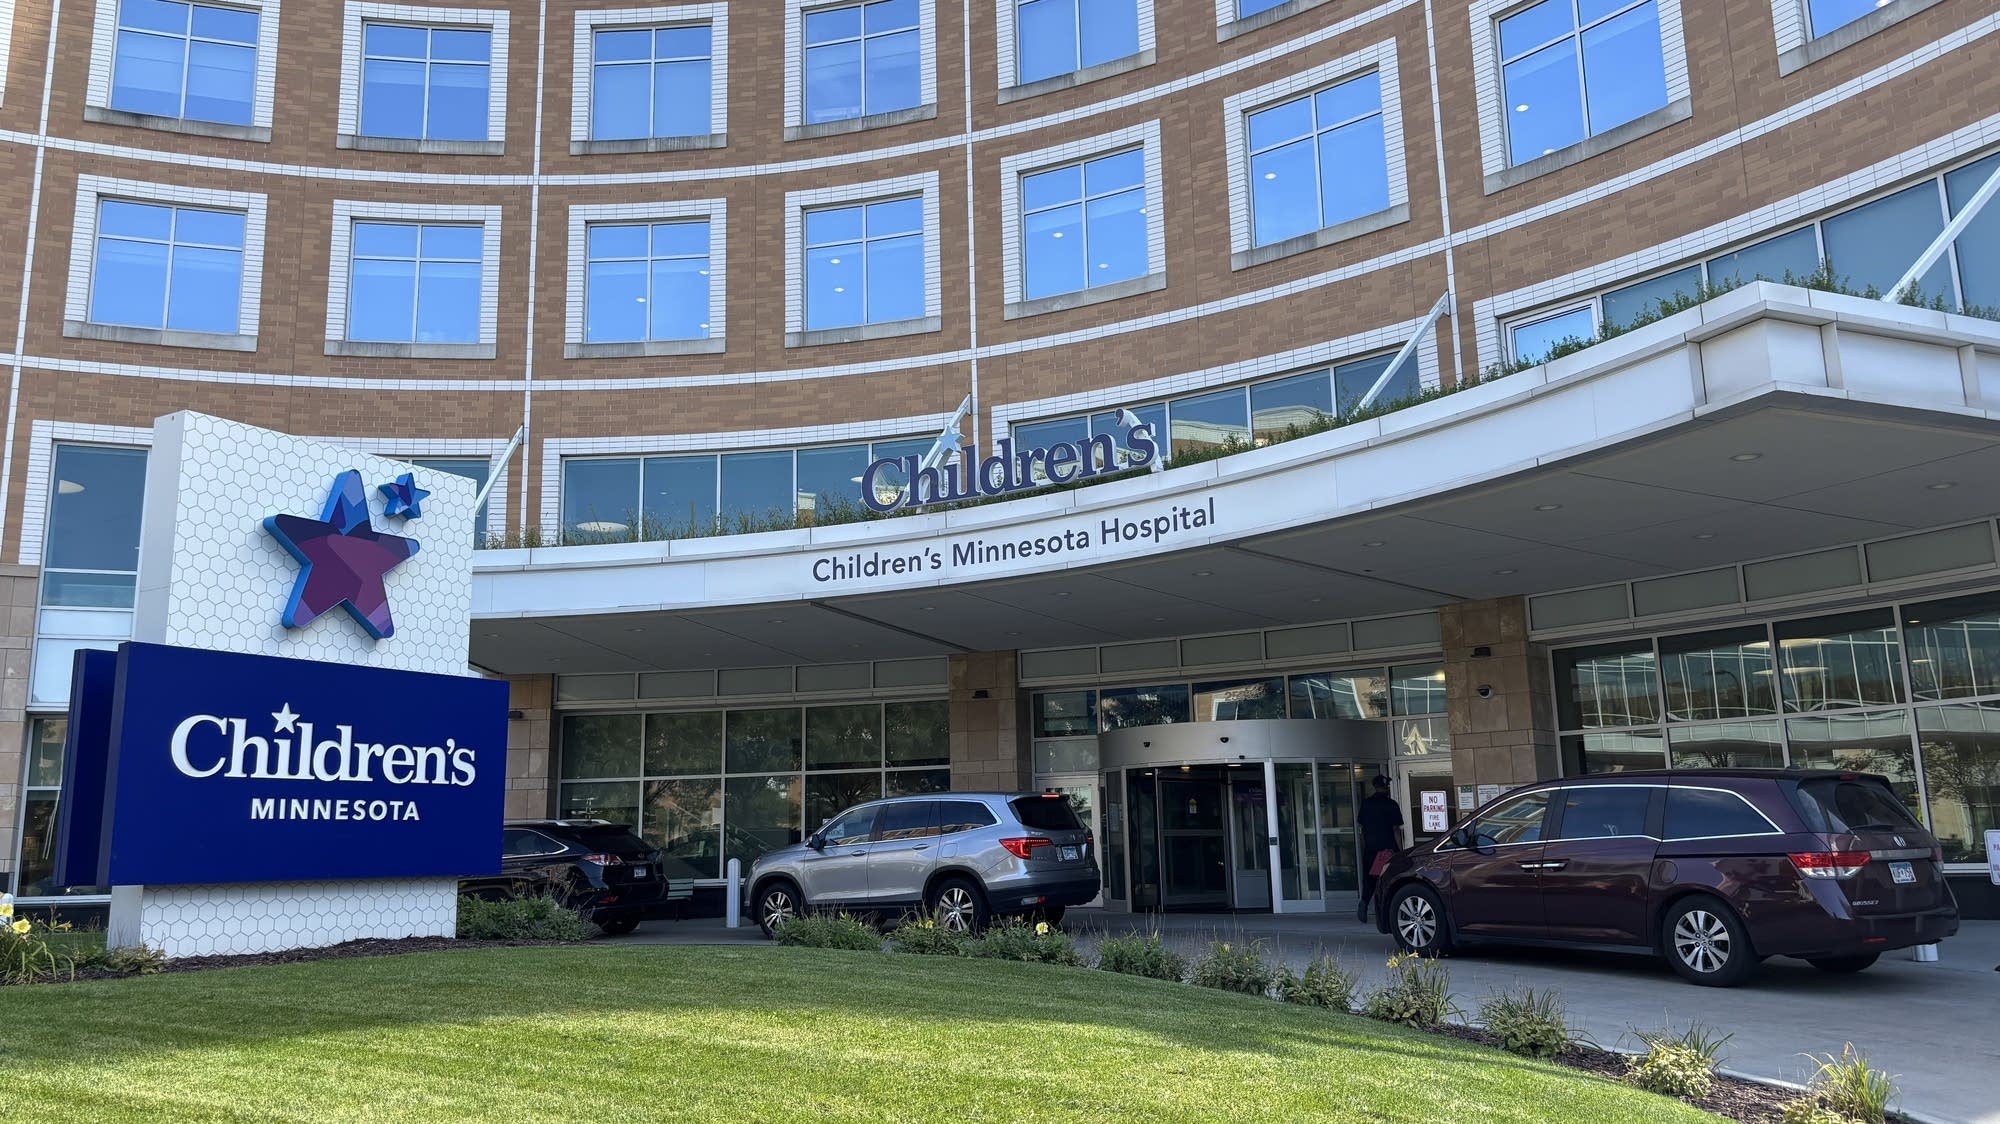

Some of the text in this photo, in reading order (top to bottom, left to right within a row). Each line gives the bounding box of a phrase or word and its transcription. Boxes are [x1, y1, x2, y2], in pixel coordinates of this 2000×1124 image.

[860, 408, 1159, 513] Children's
[812, 497, 1215, 583] Children's Minnesota Hospital
[170, 702, 476, 787] Children's
[250, 798, 420, 821] MINNESOTA
[1423, 804, 1445, 812] PARKING
[1428, 796, 1438, 804] NO
